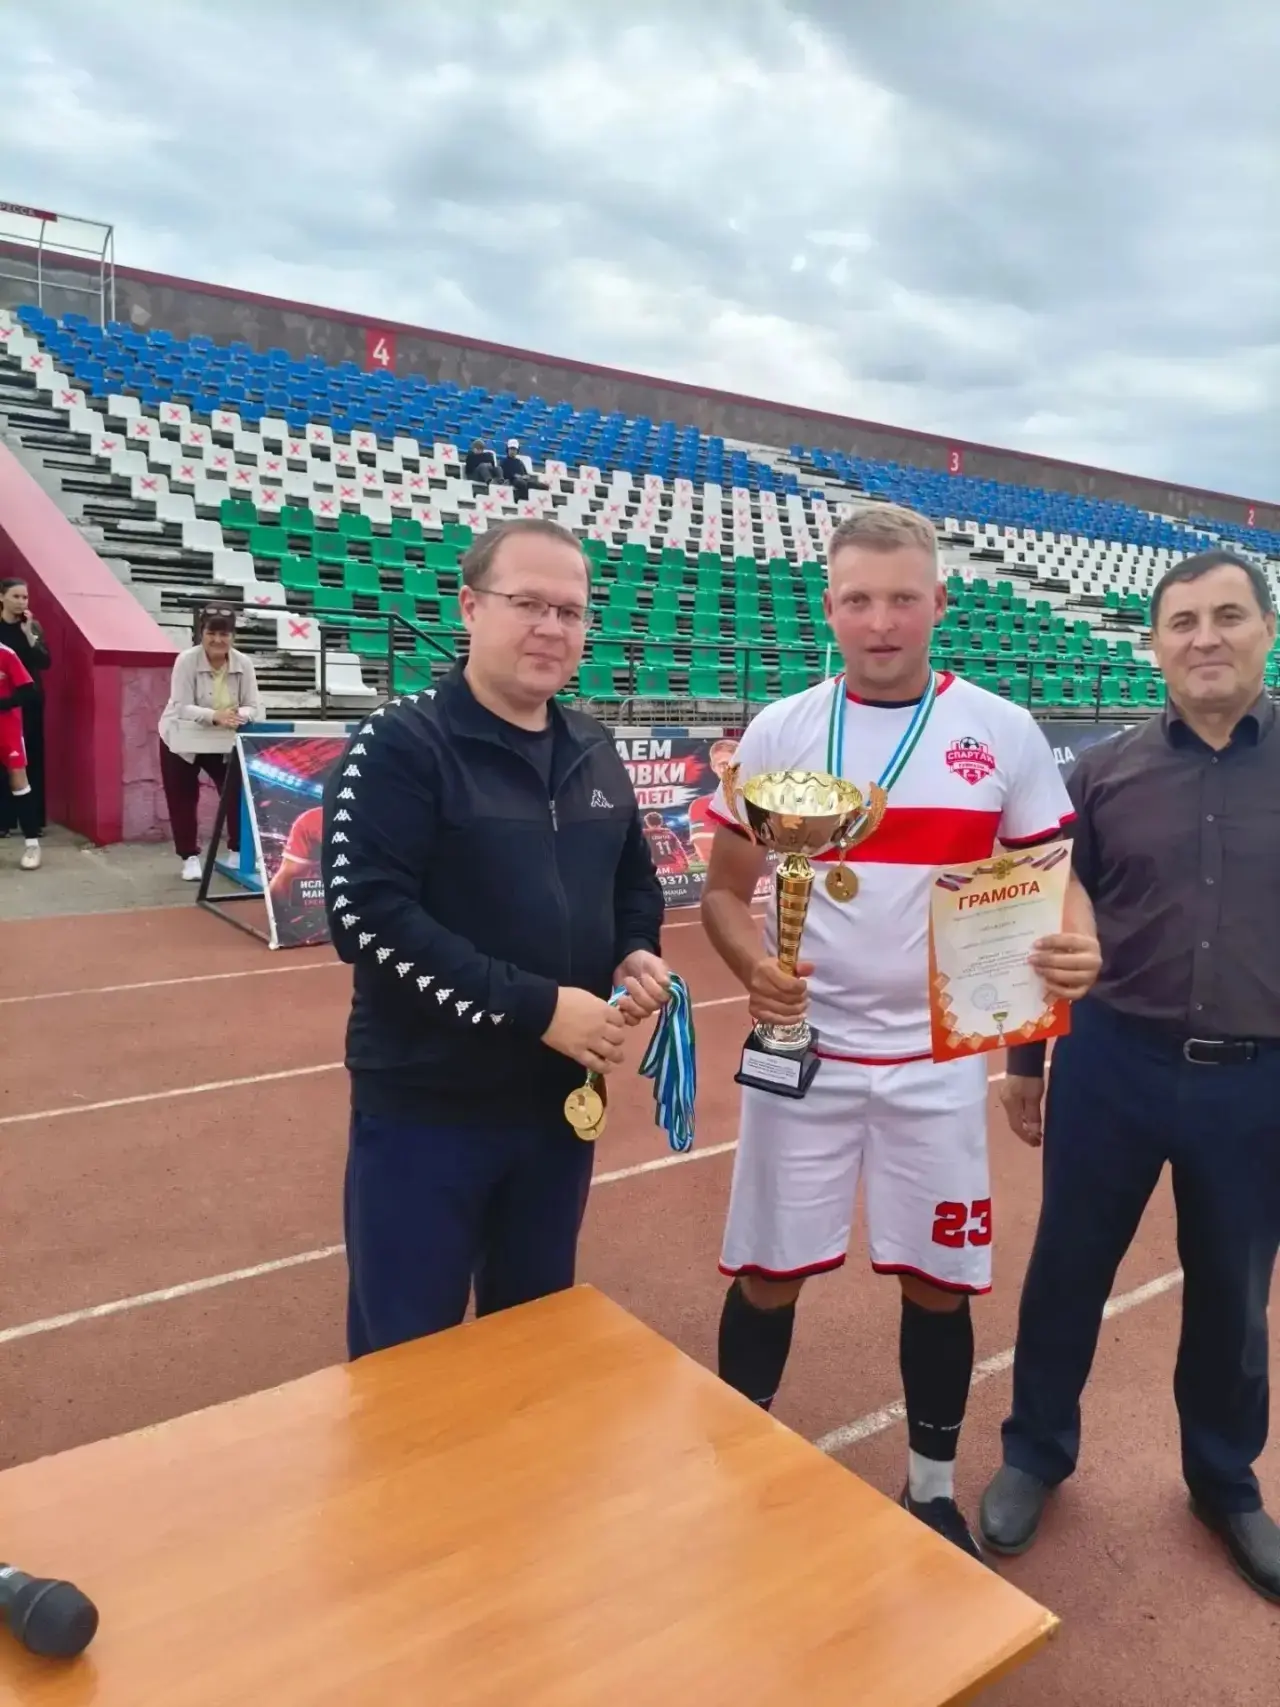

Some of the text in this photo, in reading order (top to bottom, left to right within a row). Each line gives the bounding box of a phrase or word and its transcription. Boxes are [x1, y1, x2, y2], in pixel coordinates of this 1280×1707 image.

[373, 338, 390, 366] 4
[950, 451, 959, 471] 3
[1248, 509, 1255, 526] 2
[947, 751, 994, 766] СПАРТАК
[1053, 746, 1075, 764] ДА
[655, 840, 672, 856] 11
[958, 880, 1041, 911] ГРАМОТА
[931, 1197, 992, 1248] 23
